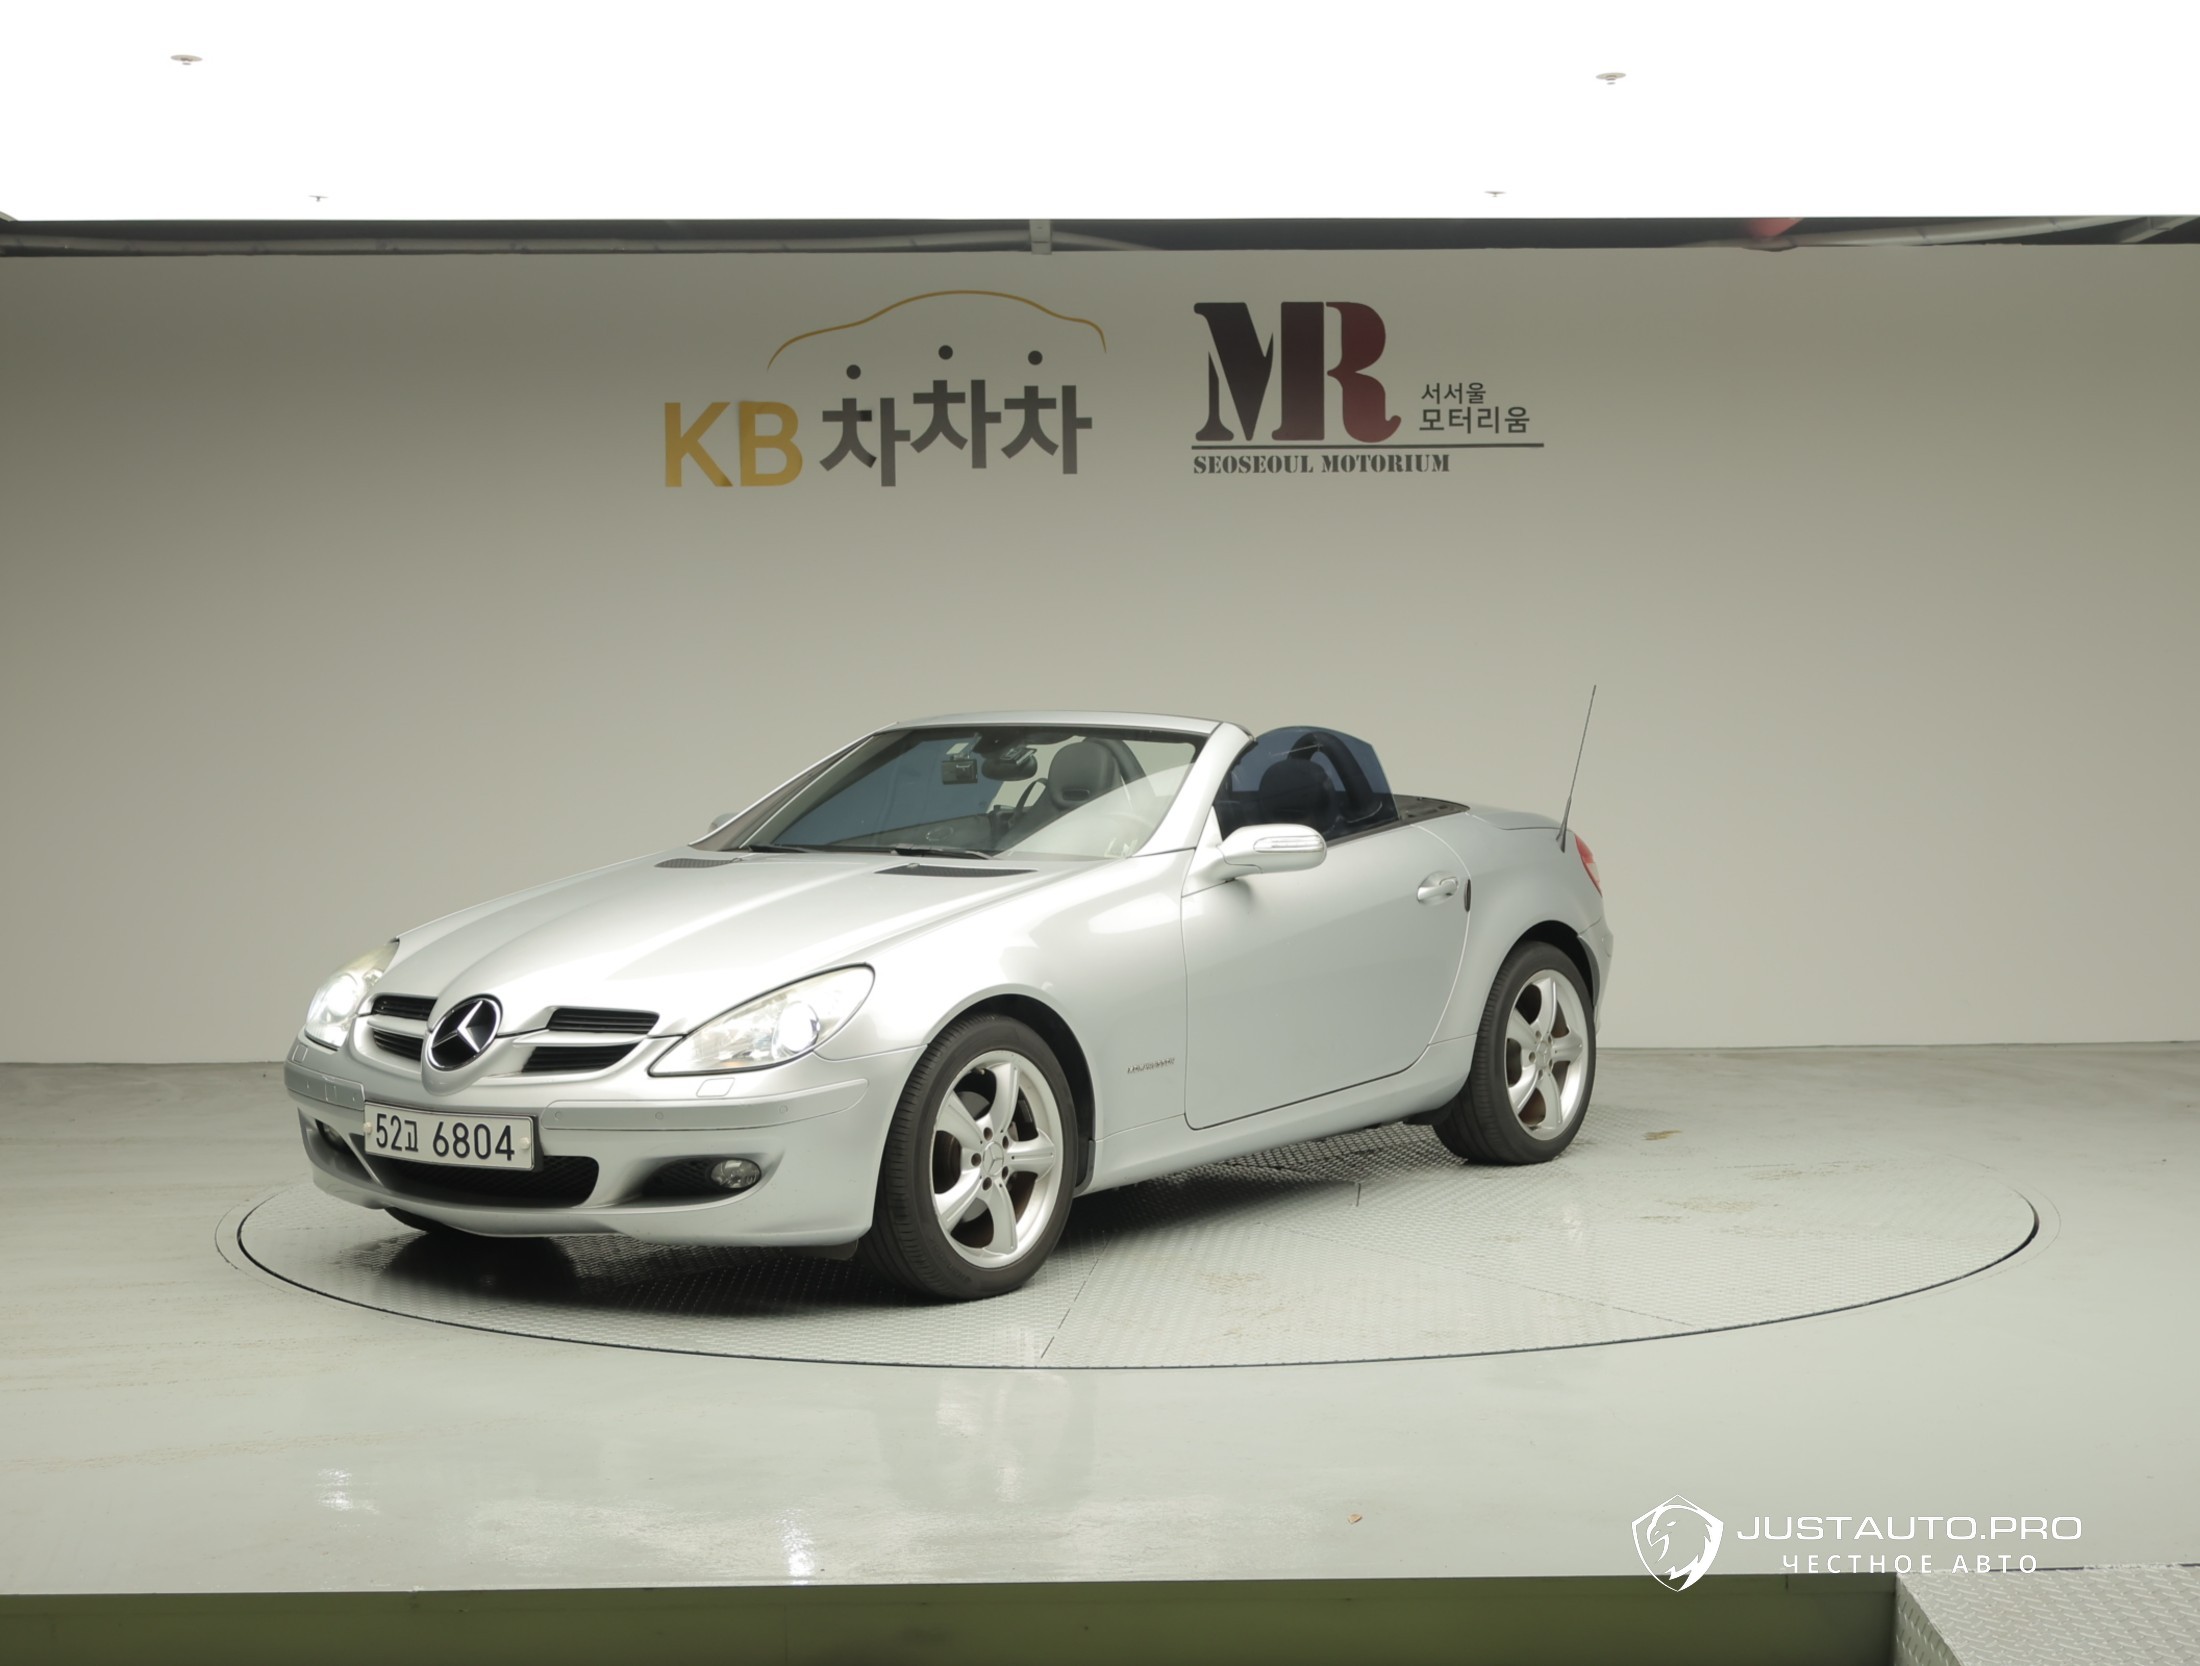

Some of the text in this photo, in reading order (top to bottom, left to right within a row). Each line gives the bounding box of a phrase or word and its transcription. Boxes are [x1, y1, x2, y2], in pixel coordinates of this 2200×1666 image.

[1193, 301, 1402, 443] MR
[1421, 382, 1487, 404] 서서울
[664, 345, 1093, 487] KB 차차차
[1419, 406, 1531, 434] 모터리움
[1193, 453, 1451, 474] SEOSEOUL MOTORIUM
[376, 1113, 515, 1162] 52고 6804
